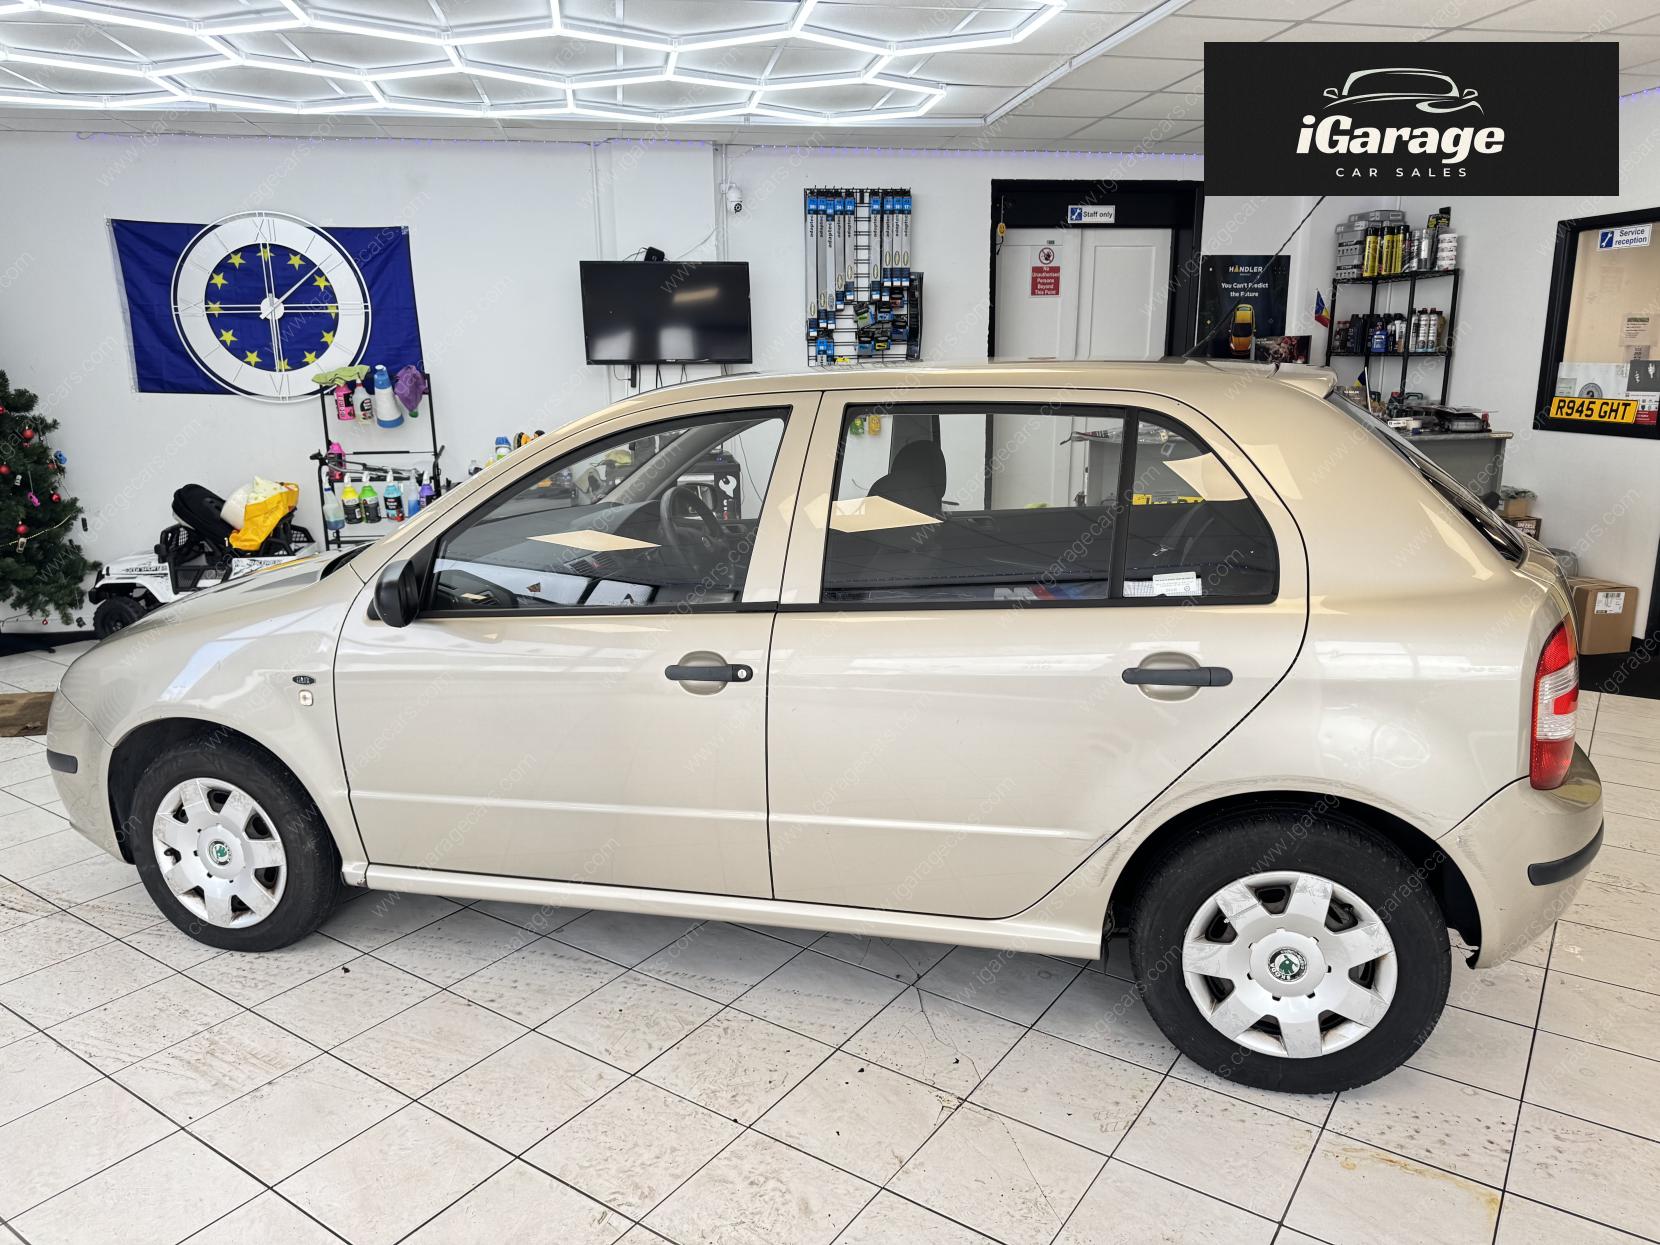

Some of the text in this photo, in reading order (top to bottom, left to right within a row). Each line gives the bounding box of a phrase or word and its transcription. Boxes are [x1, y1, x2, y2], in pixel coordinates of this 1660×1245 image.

[1099, 211, 1113, 219] only
[1619, 228, 1645, 237] Service
[1615, 236, 1647, 246] reception
[1555, 400, 1594, 418] R945
[1598, 401, 1631, 420] GHT
